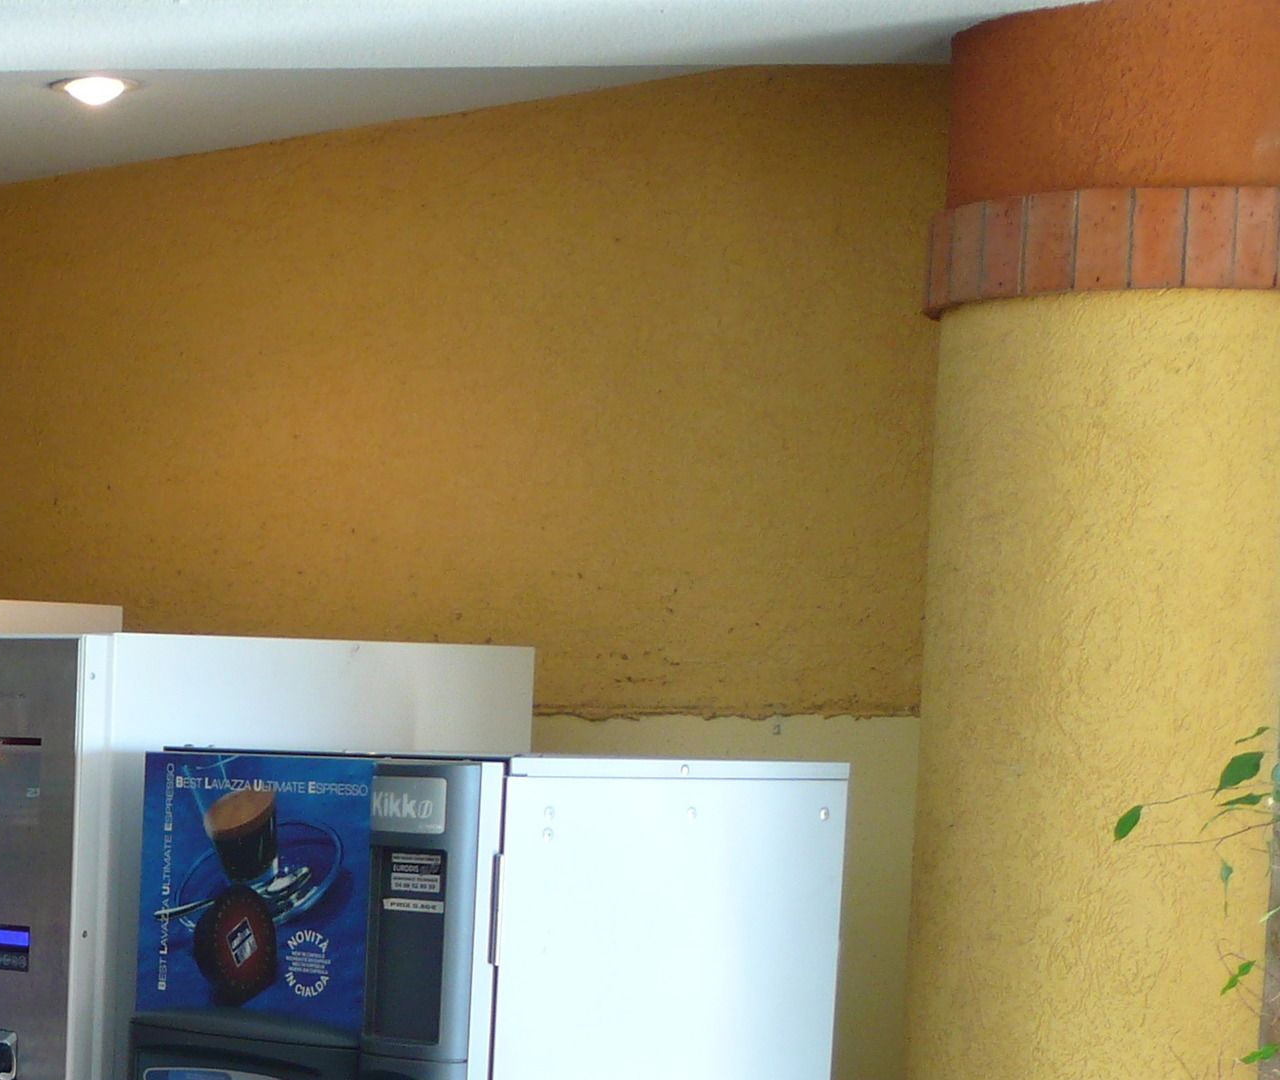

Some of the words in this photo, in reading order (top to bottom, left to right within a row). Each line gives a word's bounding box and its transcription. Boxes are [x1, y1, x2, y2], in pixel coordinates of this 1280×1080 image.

[164, 762, 176, 832] ESPRESSO
[176, 774, 203, 790] BEST
[204, 776, 252, 792] LAVAZZA
[253, 778, 306, 795] ULTIMATE
[307, 781, 369, 798] ESPRESSO
[161, 831, 174, 896] ULTIMATE
[157, 956, 168, 991] BEST
[294, 974, 330, 998] CIALDA
